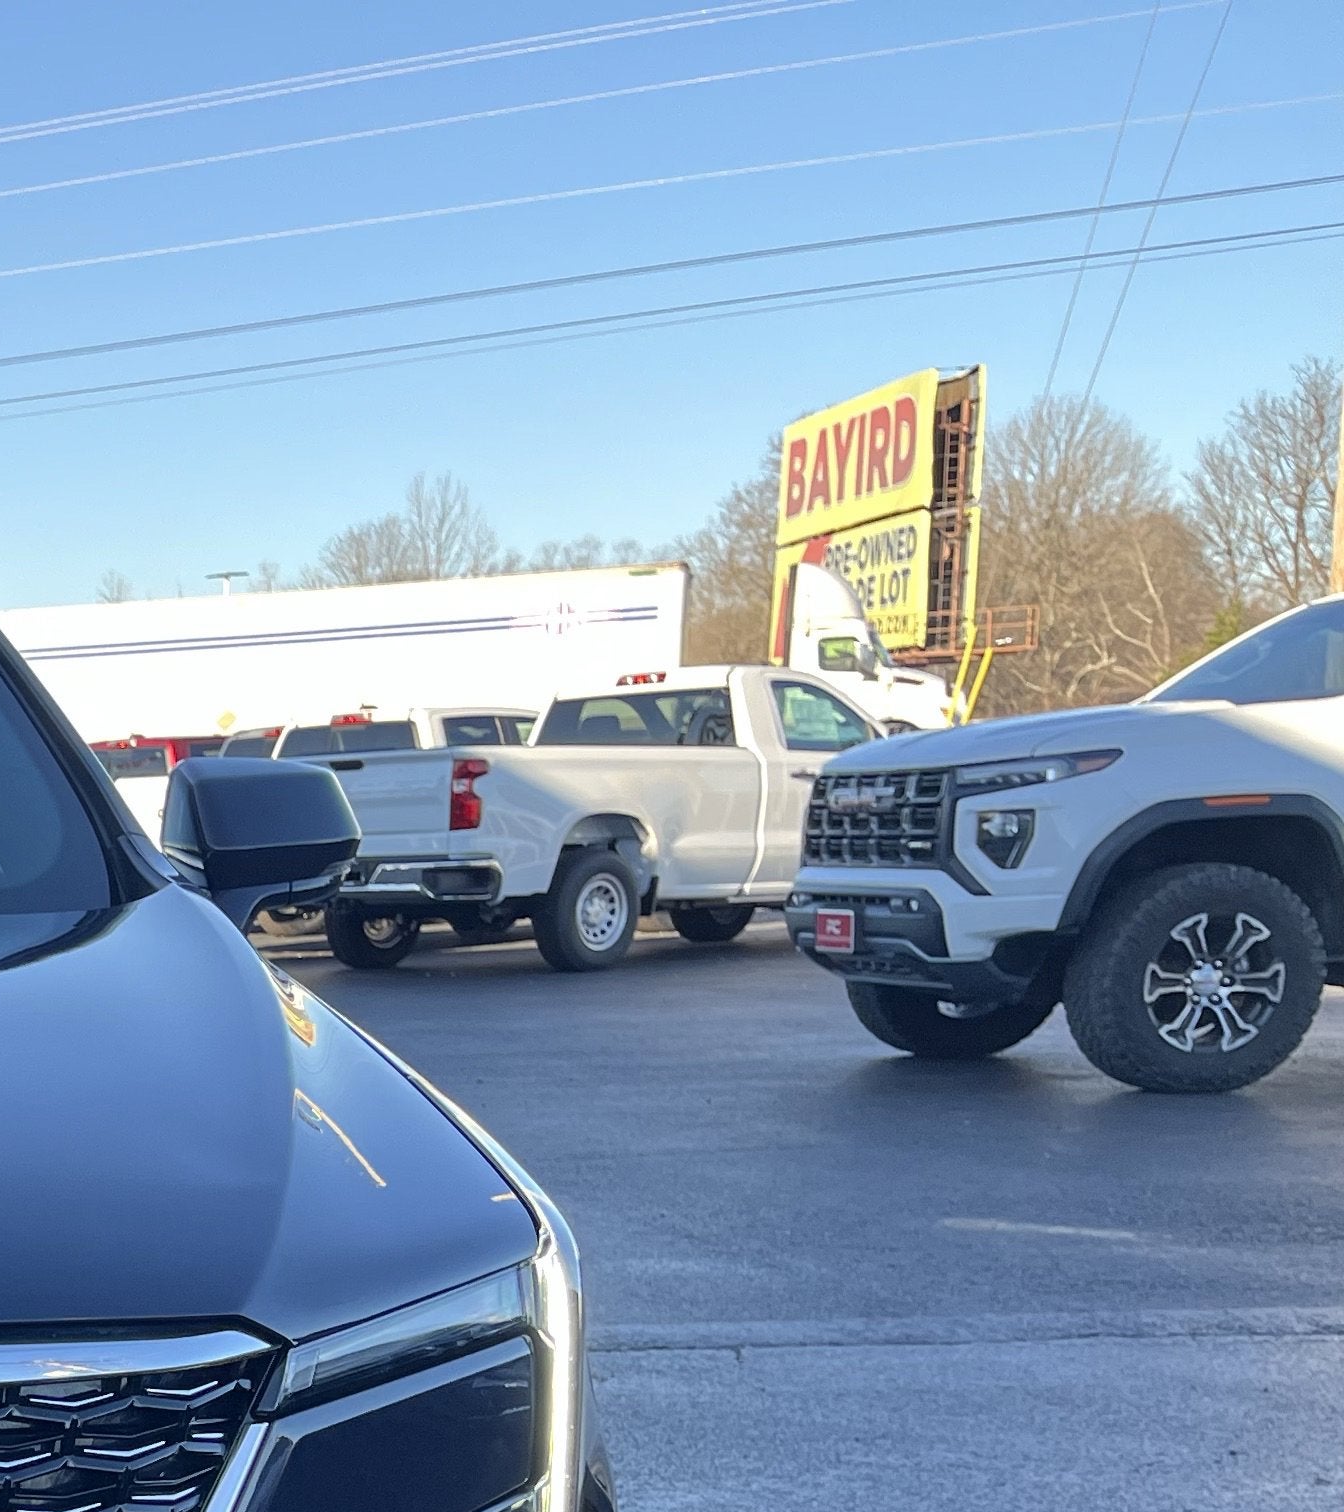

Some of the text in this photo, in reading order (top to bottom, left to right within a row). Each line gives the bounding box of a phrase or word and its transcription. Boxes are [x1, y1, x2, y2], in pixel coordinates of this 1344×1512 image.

[786, 396, 918, 520] BAYIRD
[824, 524, 918, 574] PRE-OWNED
[879, 567, 911, 607] LOT
